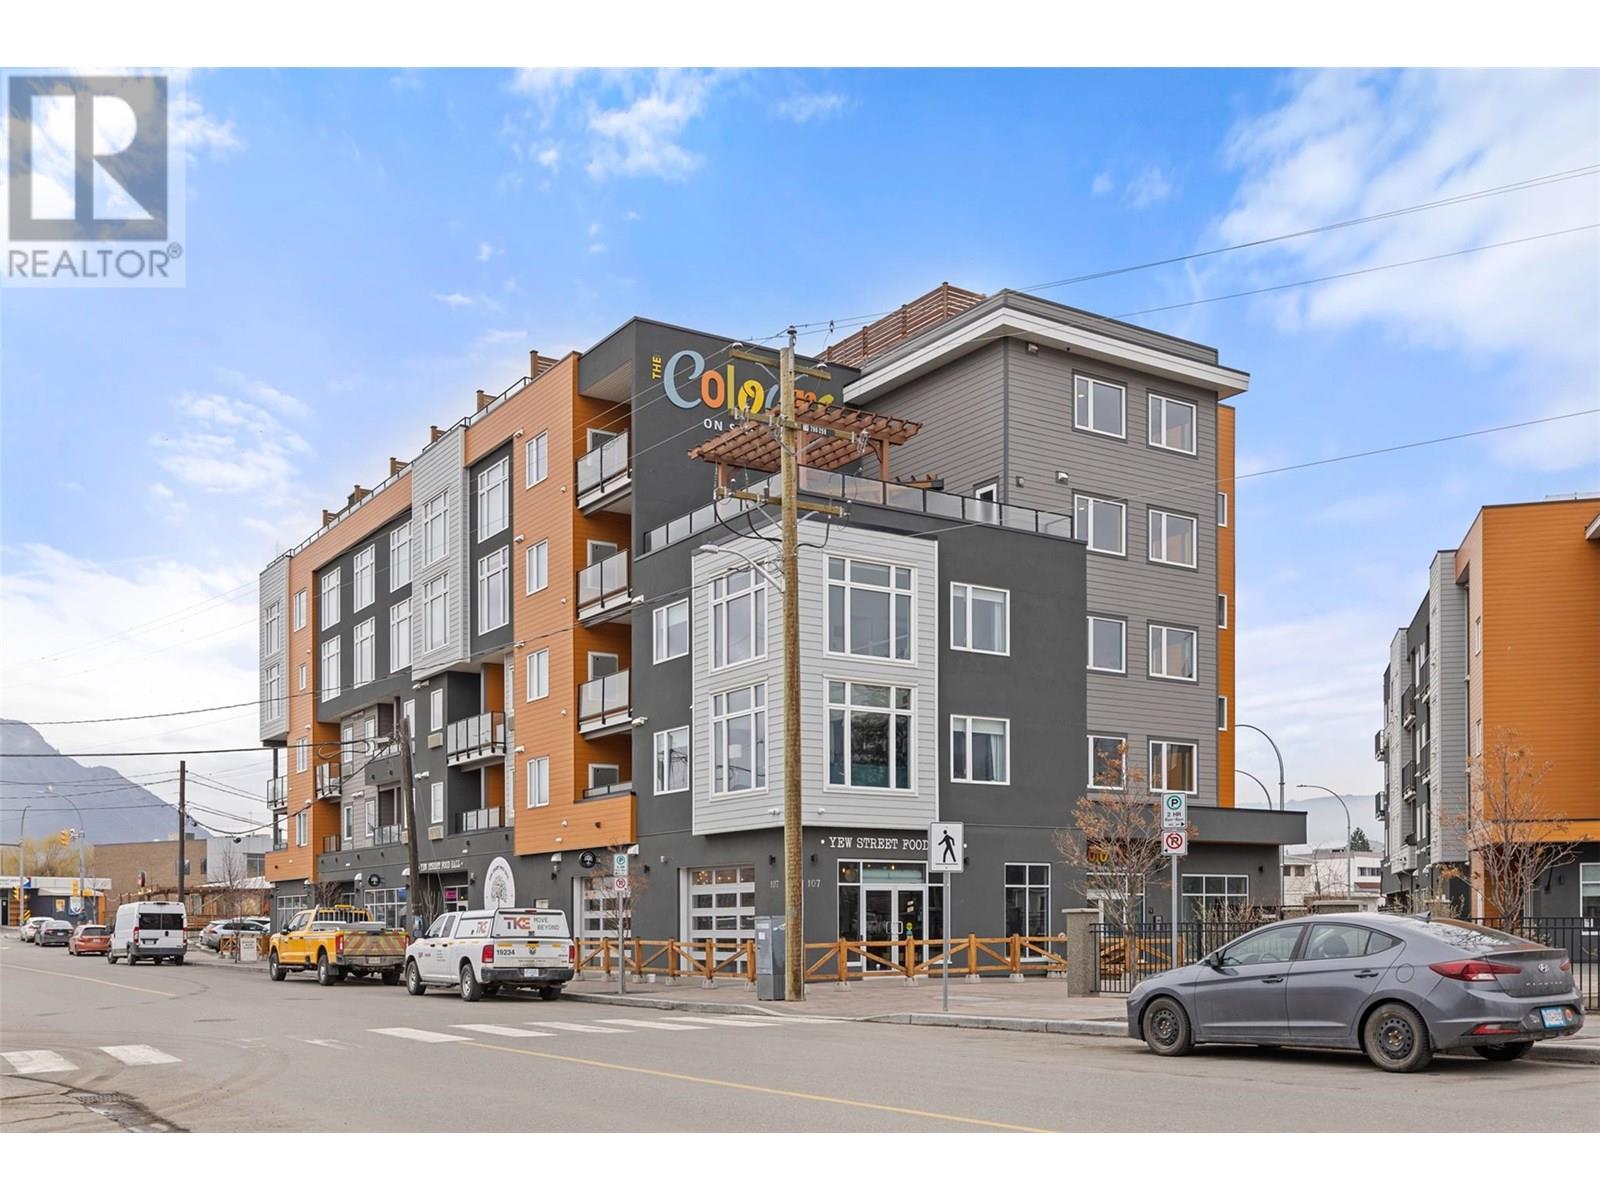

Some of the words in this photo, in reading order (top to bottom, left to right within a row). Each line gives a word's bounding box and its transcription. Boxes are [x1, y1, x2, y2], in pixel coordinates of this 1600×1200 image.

[652, 356, 662, 380] THE
[703, 418, 723, 431] ON
[828, 836, 853, 848] YEW
[856, 837, 898, 850] STREET
[902, 839, 928, 851] FOOD
[807, 879, 821, 888] 107
[503, 917, 531, 930] TKE
